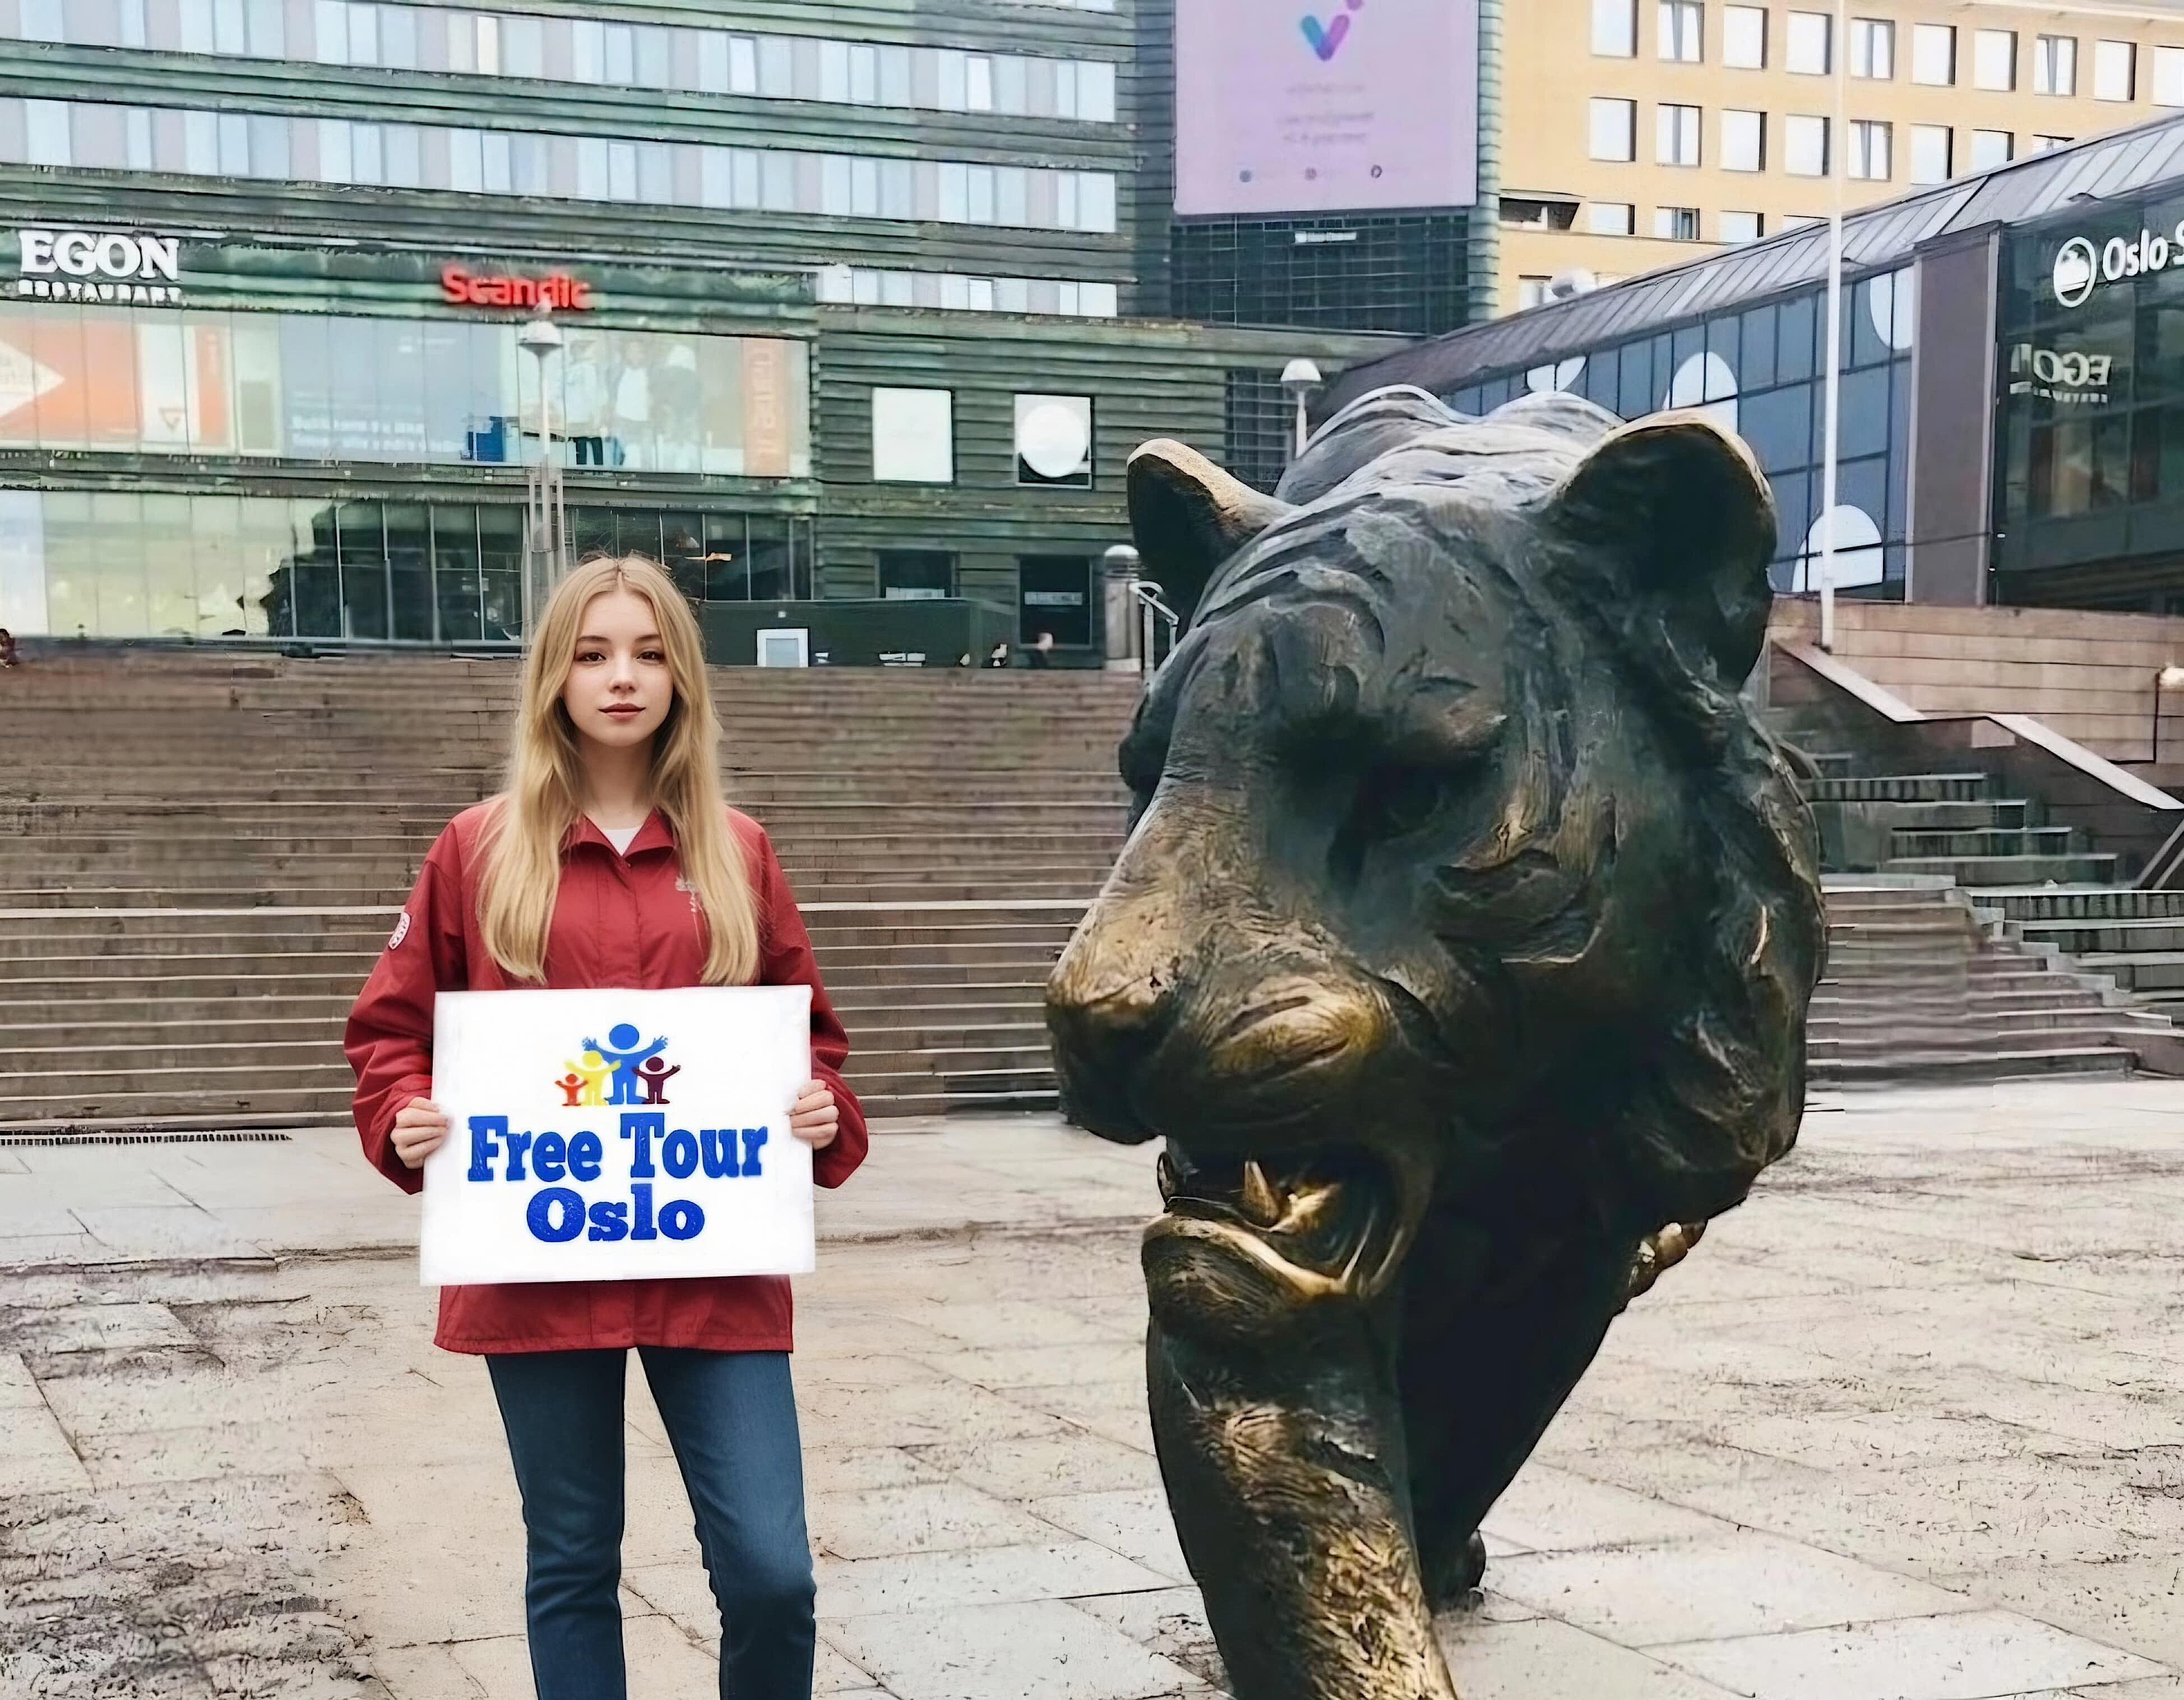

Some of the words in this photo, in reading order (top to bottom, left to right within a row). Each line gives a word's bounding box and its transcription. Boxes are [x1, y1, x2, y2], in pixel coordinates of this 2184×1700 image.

[19, 230, 180, 281] EGON
[2103, 228, 2168, 281] Oslo
[442, 266, 594, 309] Scandic
[468, 1115, 603, 1182] Free
[620, 1112, 769, 1179] Tour
[526, 1183, 705, 1242] Oslo
